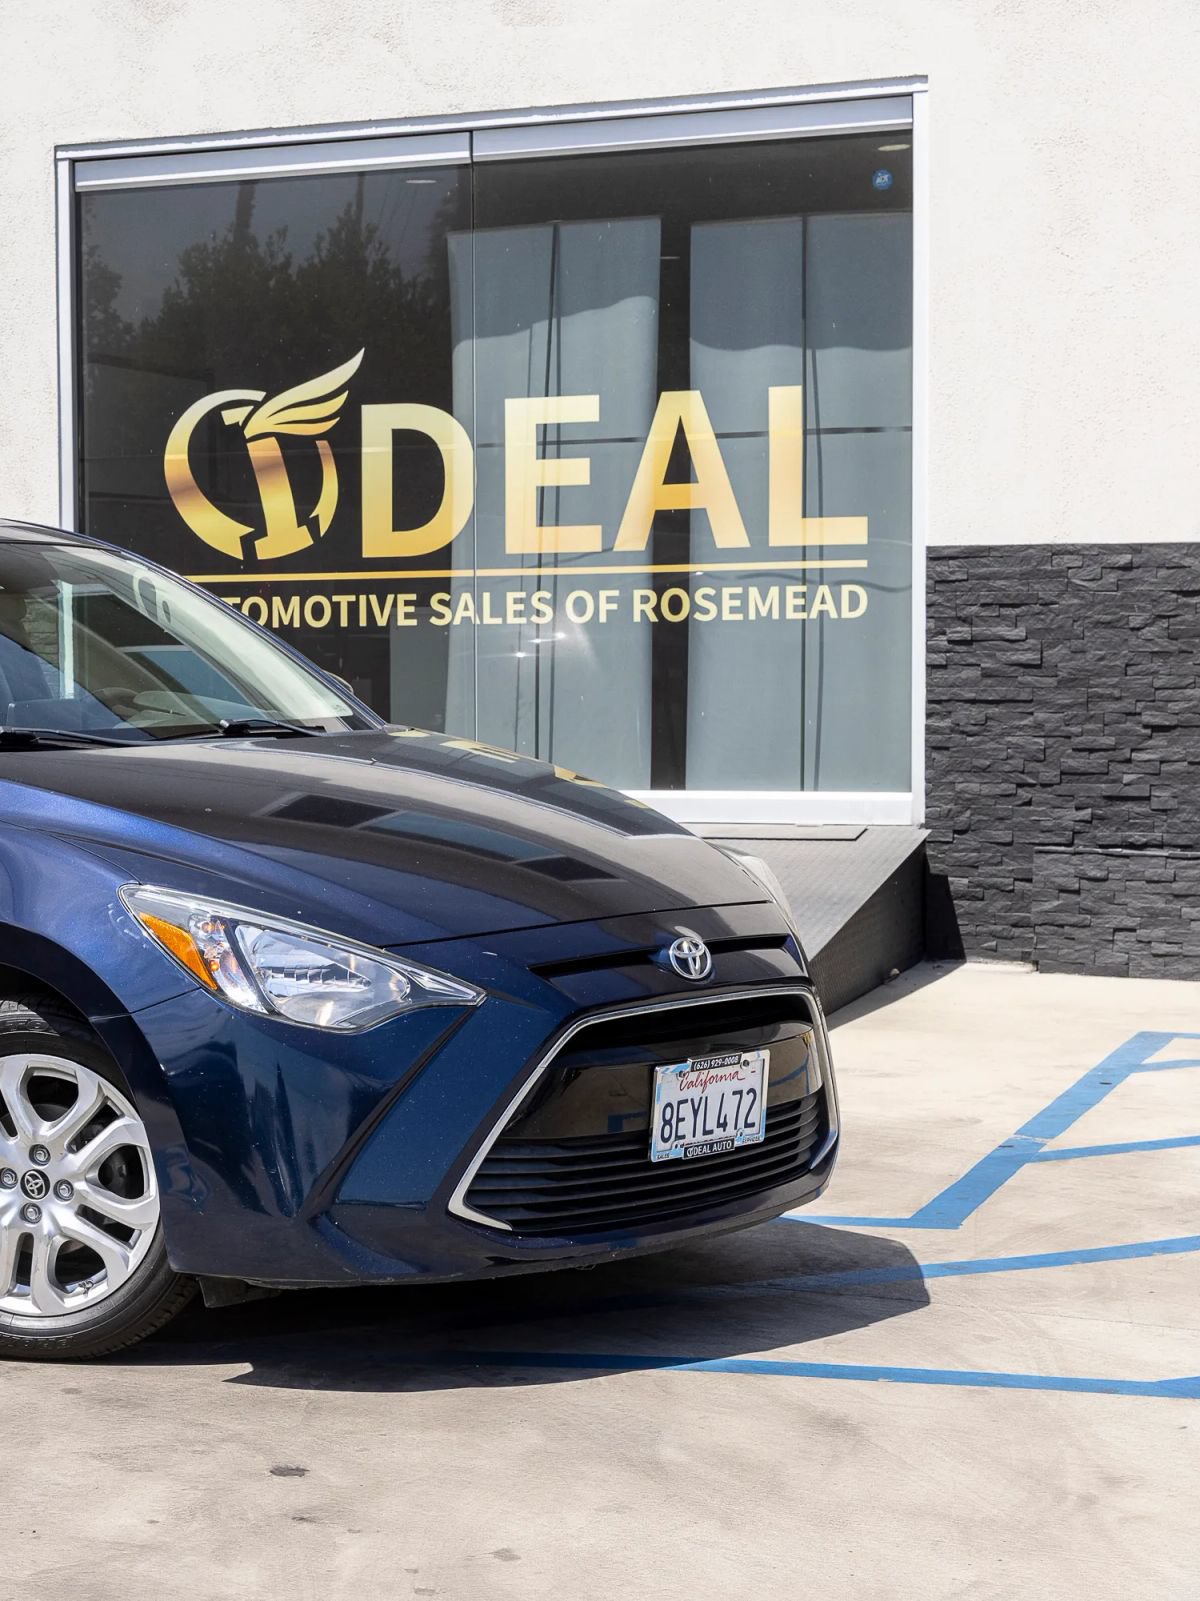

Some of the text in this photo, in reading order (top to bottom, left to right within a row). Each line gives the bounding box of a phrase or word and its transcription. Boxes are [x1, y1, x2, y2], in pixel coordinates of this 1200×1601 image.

[429, 590, 554, 626] SALES
[565, 588, 619, 625] OF
[634, 584, 869, 623] ROSEMEAD
[680, 1070, 746, 1094] California
[660, 1088, 757, 1144] 8EYL472
[713, 1140, 732, 1152] AUTO
